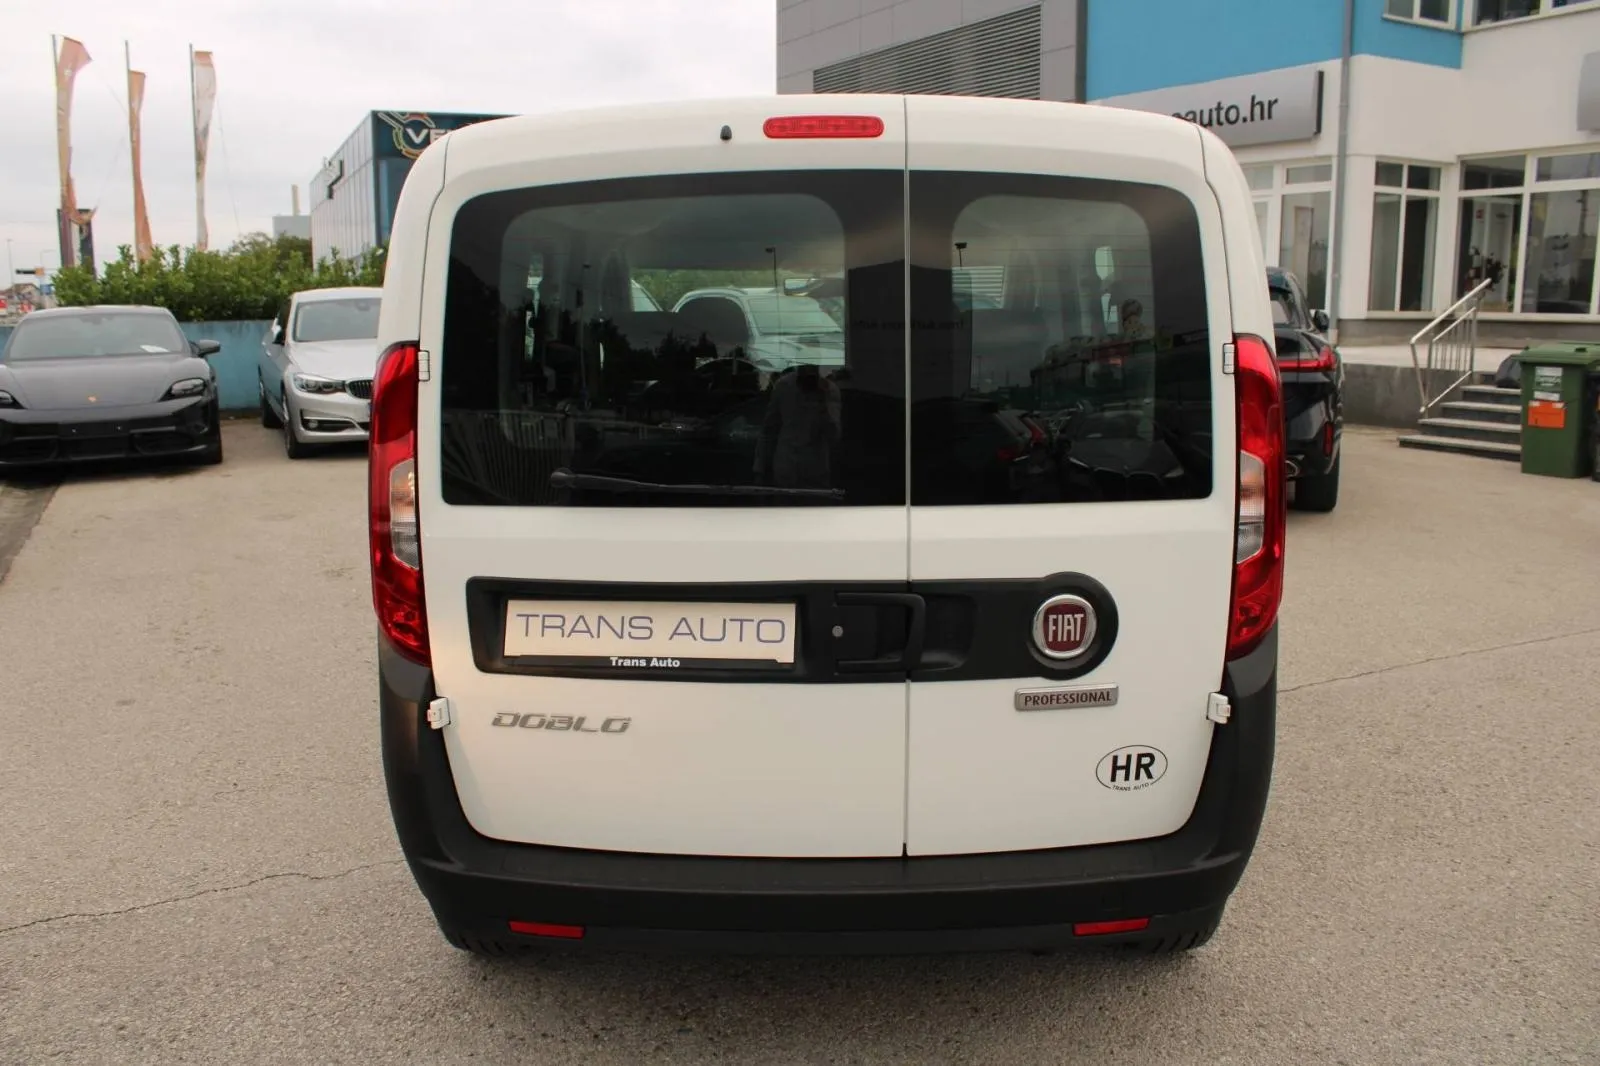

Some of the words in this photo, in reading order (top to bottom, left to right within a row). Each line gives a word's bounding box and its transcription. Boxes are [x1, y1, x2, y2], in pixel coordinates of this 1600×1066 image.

[516, 613, 653, 640] TRANS
[668, 617, 786, 644] AUTO
[1048, 613, 1085, 643] FIAT
[610, 656, 647, 667] Trans
[650, 657, 681, 668] Auto
[1023, 690, 1112, 707] PROFESSIONAL
[490, 711, 632, 734] DOBLO
[1110, 752, 1156, 783] HR
[1112, 784, 1131, 792] TRANS
[1133, 782, 1150, 791] AUTO
